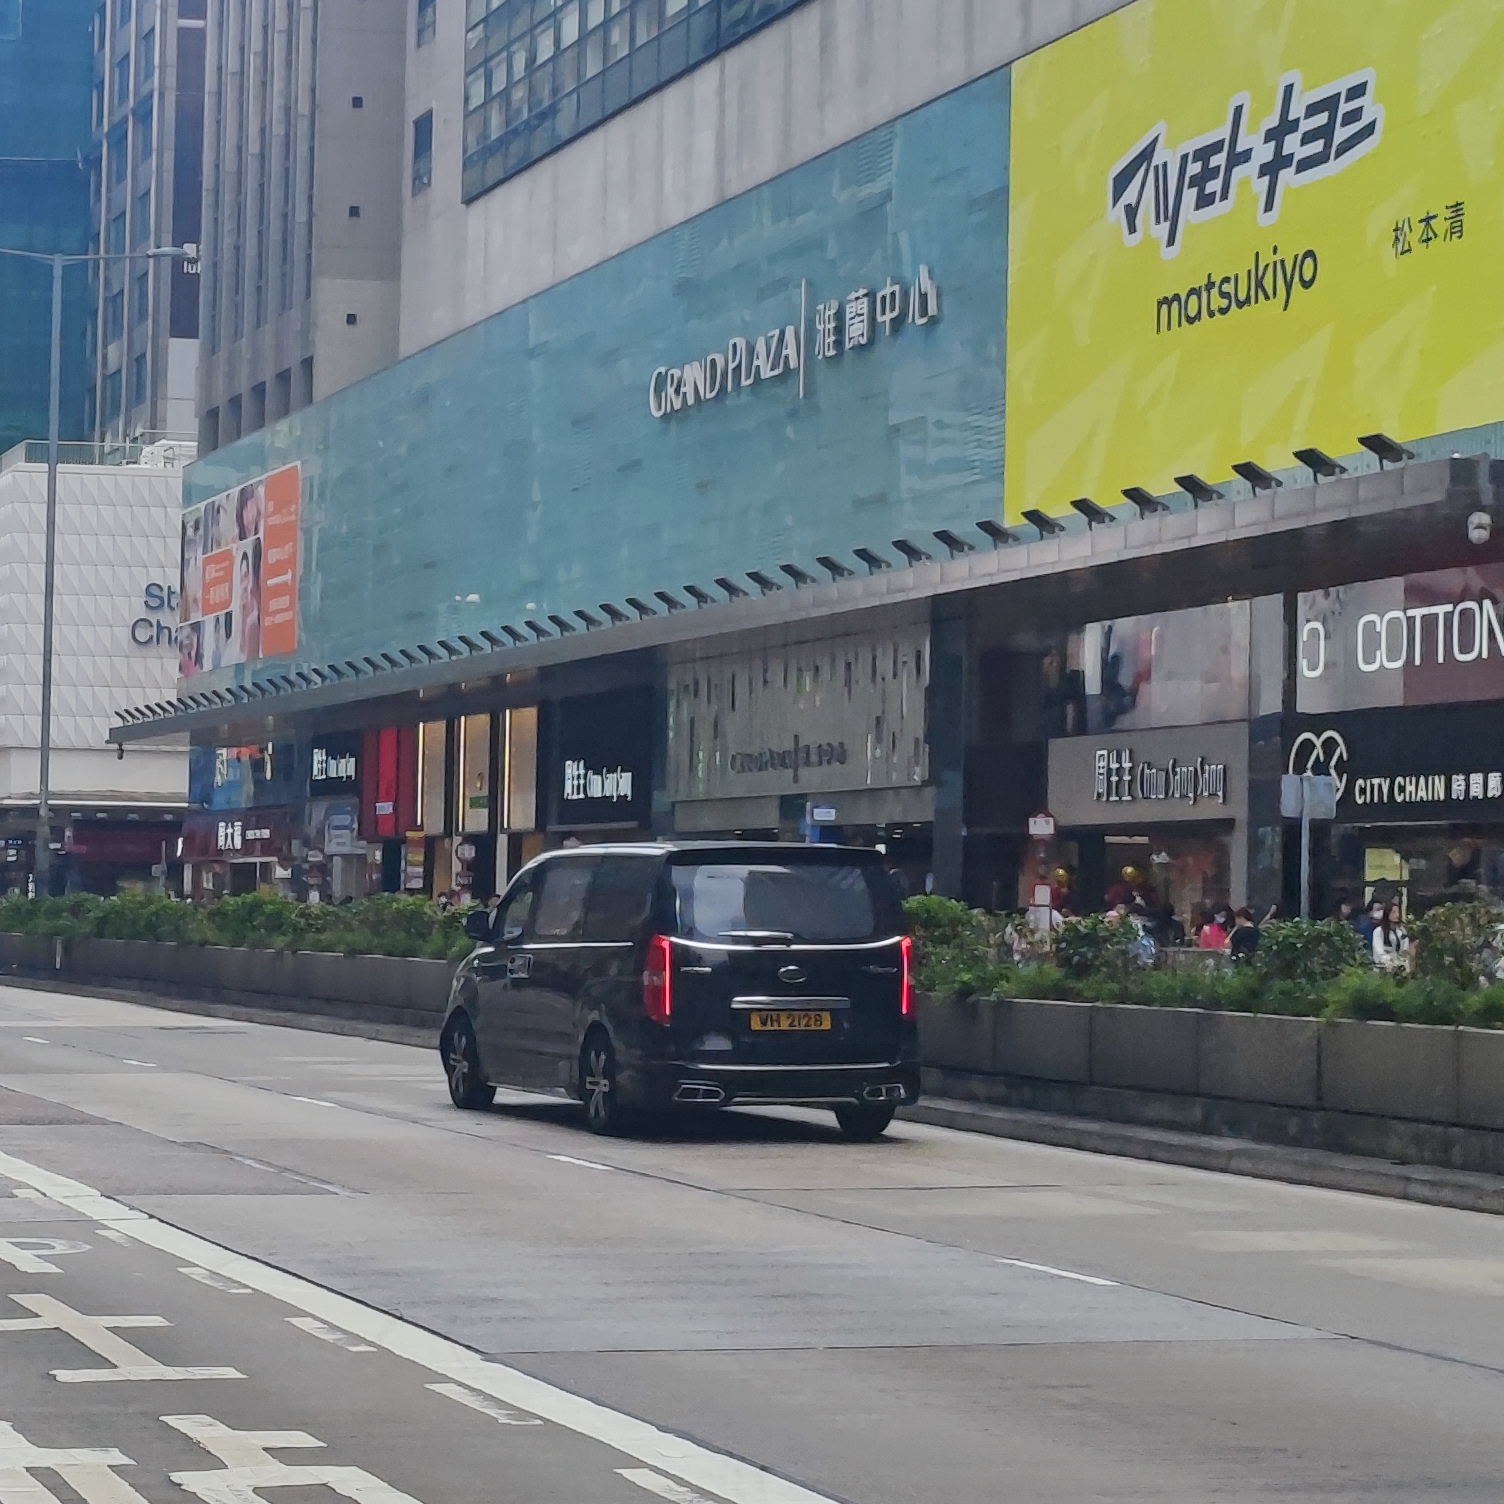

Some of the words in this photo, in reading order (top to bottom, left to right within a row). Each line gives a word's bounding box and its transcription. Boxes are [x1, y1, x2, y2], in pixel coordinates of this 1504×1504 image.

[1392, 201, 1465, 259] 松本清
[815, 264, 937, 359] 雅蘭中心
[1156, 244, 1318, 335] matsukiyo
[1093, 748, 1134, 802] 周生生
[1355, 776, 1390, 805] CITY
[1394, 774, 1445, 803] CHAIN
